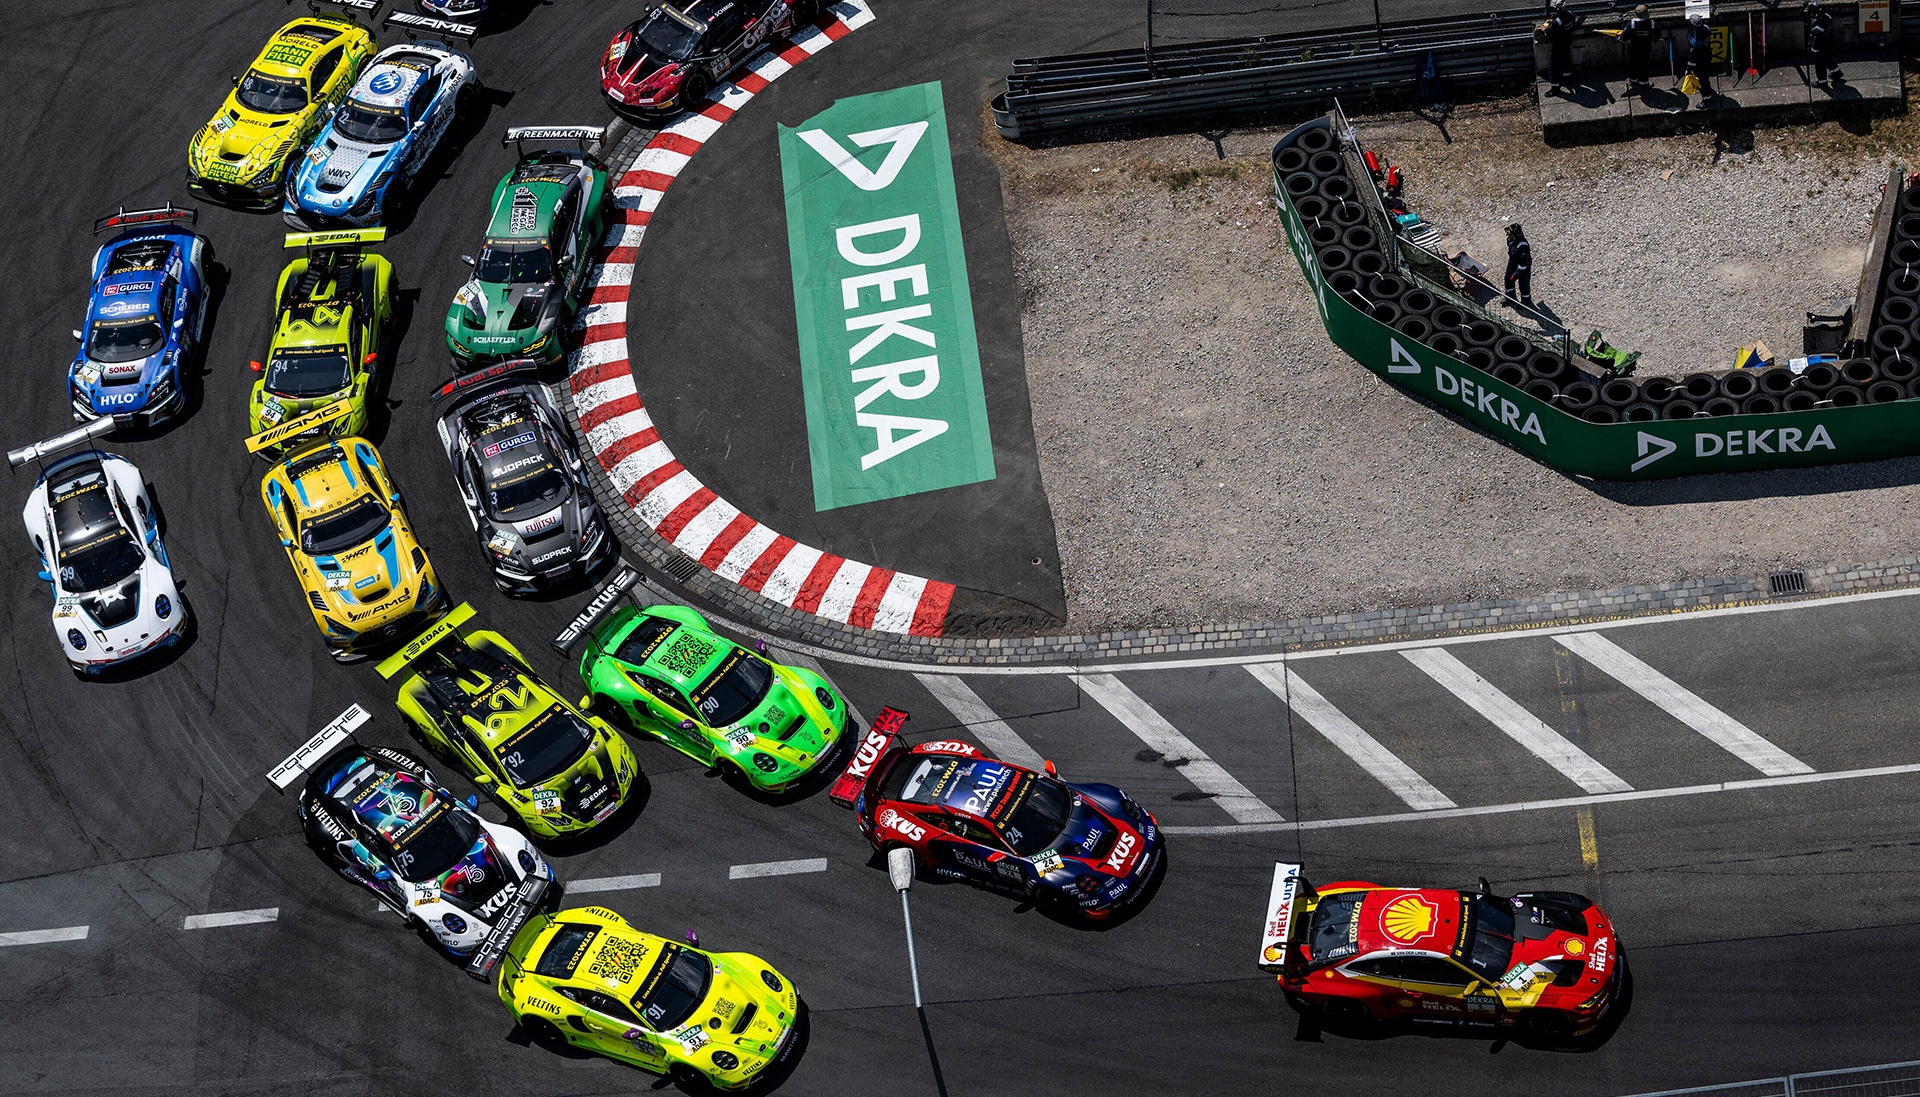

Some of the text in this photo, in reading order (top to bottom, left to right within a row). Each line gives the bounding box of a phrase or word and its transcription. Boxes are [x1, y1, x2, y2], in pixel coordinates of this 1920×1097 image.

[1869, 10, 1880, 20] 4
[416, 17, 477, 35] AMG
[265, 51, 305, 64] FILTER
[270, 44, 310, 57] MANN
[448, 73, 464, 91] PARAT
[239, 118, 268, 128] MORELO
[208, 169, 236, 182] FILTER
[211, 162, 239, 172] MANN
[124, 211, 186, 223] Audi Sport
[120, 283, 152, 292] GURGL
[100, 303, 150, 315] SCHERER
[92, 330, 98, 342] 7
[473, 336, 516, 344] SCHAEFFLER
[835, 213, 949, 471] DEKRA
[109, 365, 136, 374] SONAX
[275, 360, 288, 372] 94
[458, 360, 523, 387] Audi Sport
[264, 409, 276, 419] 94
[266, 401, 286, 414] DEKRA
[1436, 366, 1548, 446] DEKRA
[285, 405, 340, 433] AMG
[500, 433, 535, 450] GURGL
[1695, 424, 1836, 458] DEKRA
[490, 491, 498, 505] 3
[525, 514, 557, 533] FUJITSU
[305, 534, 312, 548] 4
[500, 539, 507, 547] 3
[62, 566, 75, 581] 99
[372, 594, 411, 615] AMG
[569, 584, 618, 633] PILATUS
[421, 625, 445, 645] EDAG
[640, 626, 674, 659] DTM 2023
[703, 696, 720, 714] 90
[726, 726, 750, 740] DEKRA
[735, 734, 749, 744] 90
[271, 707, 361, 780] PORSCHE
[379, 748, 416, 769] VELTINS
[508, 751, 525, 768] 92
[847, 729, 888, 778] KÜS
[932, 760, 959, 798] DTM 2023
[353, 773, 391, 804] DTM 2023
[534, 791, 558, 800] DEKRA
[590, 785, 608, 802] EDAG
[965, 767, 1006, 813] PAUL
[540, 807, 558, 816] ADAC
[541, 799, 554, 808] 92
[315, 807, 345, 841] VELTINS
[889, 811, 926, 842] KÜS
[1006, 826, 1023, 846] 24
[1083, 828, 1100, 850] PAUL
[398, 849, 415, 867] 75
[1032, 849, 1058, 864] DEKRA
[1107, 832, 1136, 871] KÜS
[1042, 858, 1055, 868] 24
[458, 864, 485, 884] 75
[422, 890, 432, 898] 75
[1109, 883, 1128, 898] PAUL
[418, 897, 435, 906] ADAC
[480, 882, 518, 918] KÜS
[585, 907, 620, 922] VELTINS
[1276, 901, 1290, 937] HELIX
[1349, 901, 1362, 943] DTM 2023
[472, 881, 533, 968] PORSCHE
[1268, 921, 1277, 937] Shell
[567, 931, 596, 971] DTM 2023
[1594, 936, 1608, 972] HELIX
[1473, 958, 1488, 969] 1
[1588, 952, 1597, 969] Shell
[1503, 964, 1527, 983] DEKRA
[1518, 975, 1527, 984] 1
[527, 996, 561, 1015] VELTINS
[1467, 996, 1495, 1004] DEKRA
[647, 1003, 666, 1020] 91
[678, 1025, 702, 1041] DEKRA
[688, 1035, 702, 1046] 91
[743, 1060, 763, 1076] VELTINS
